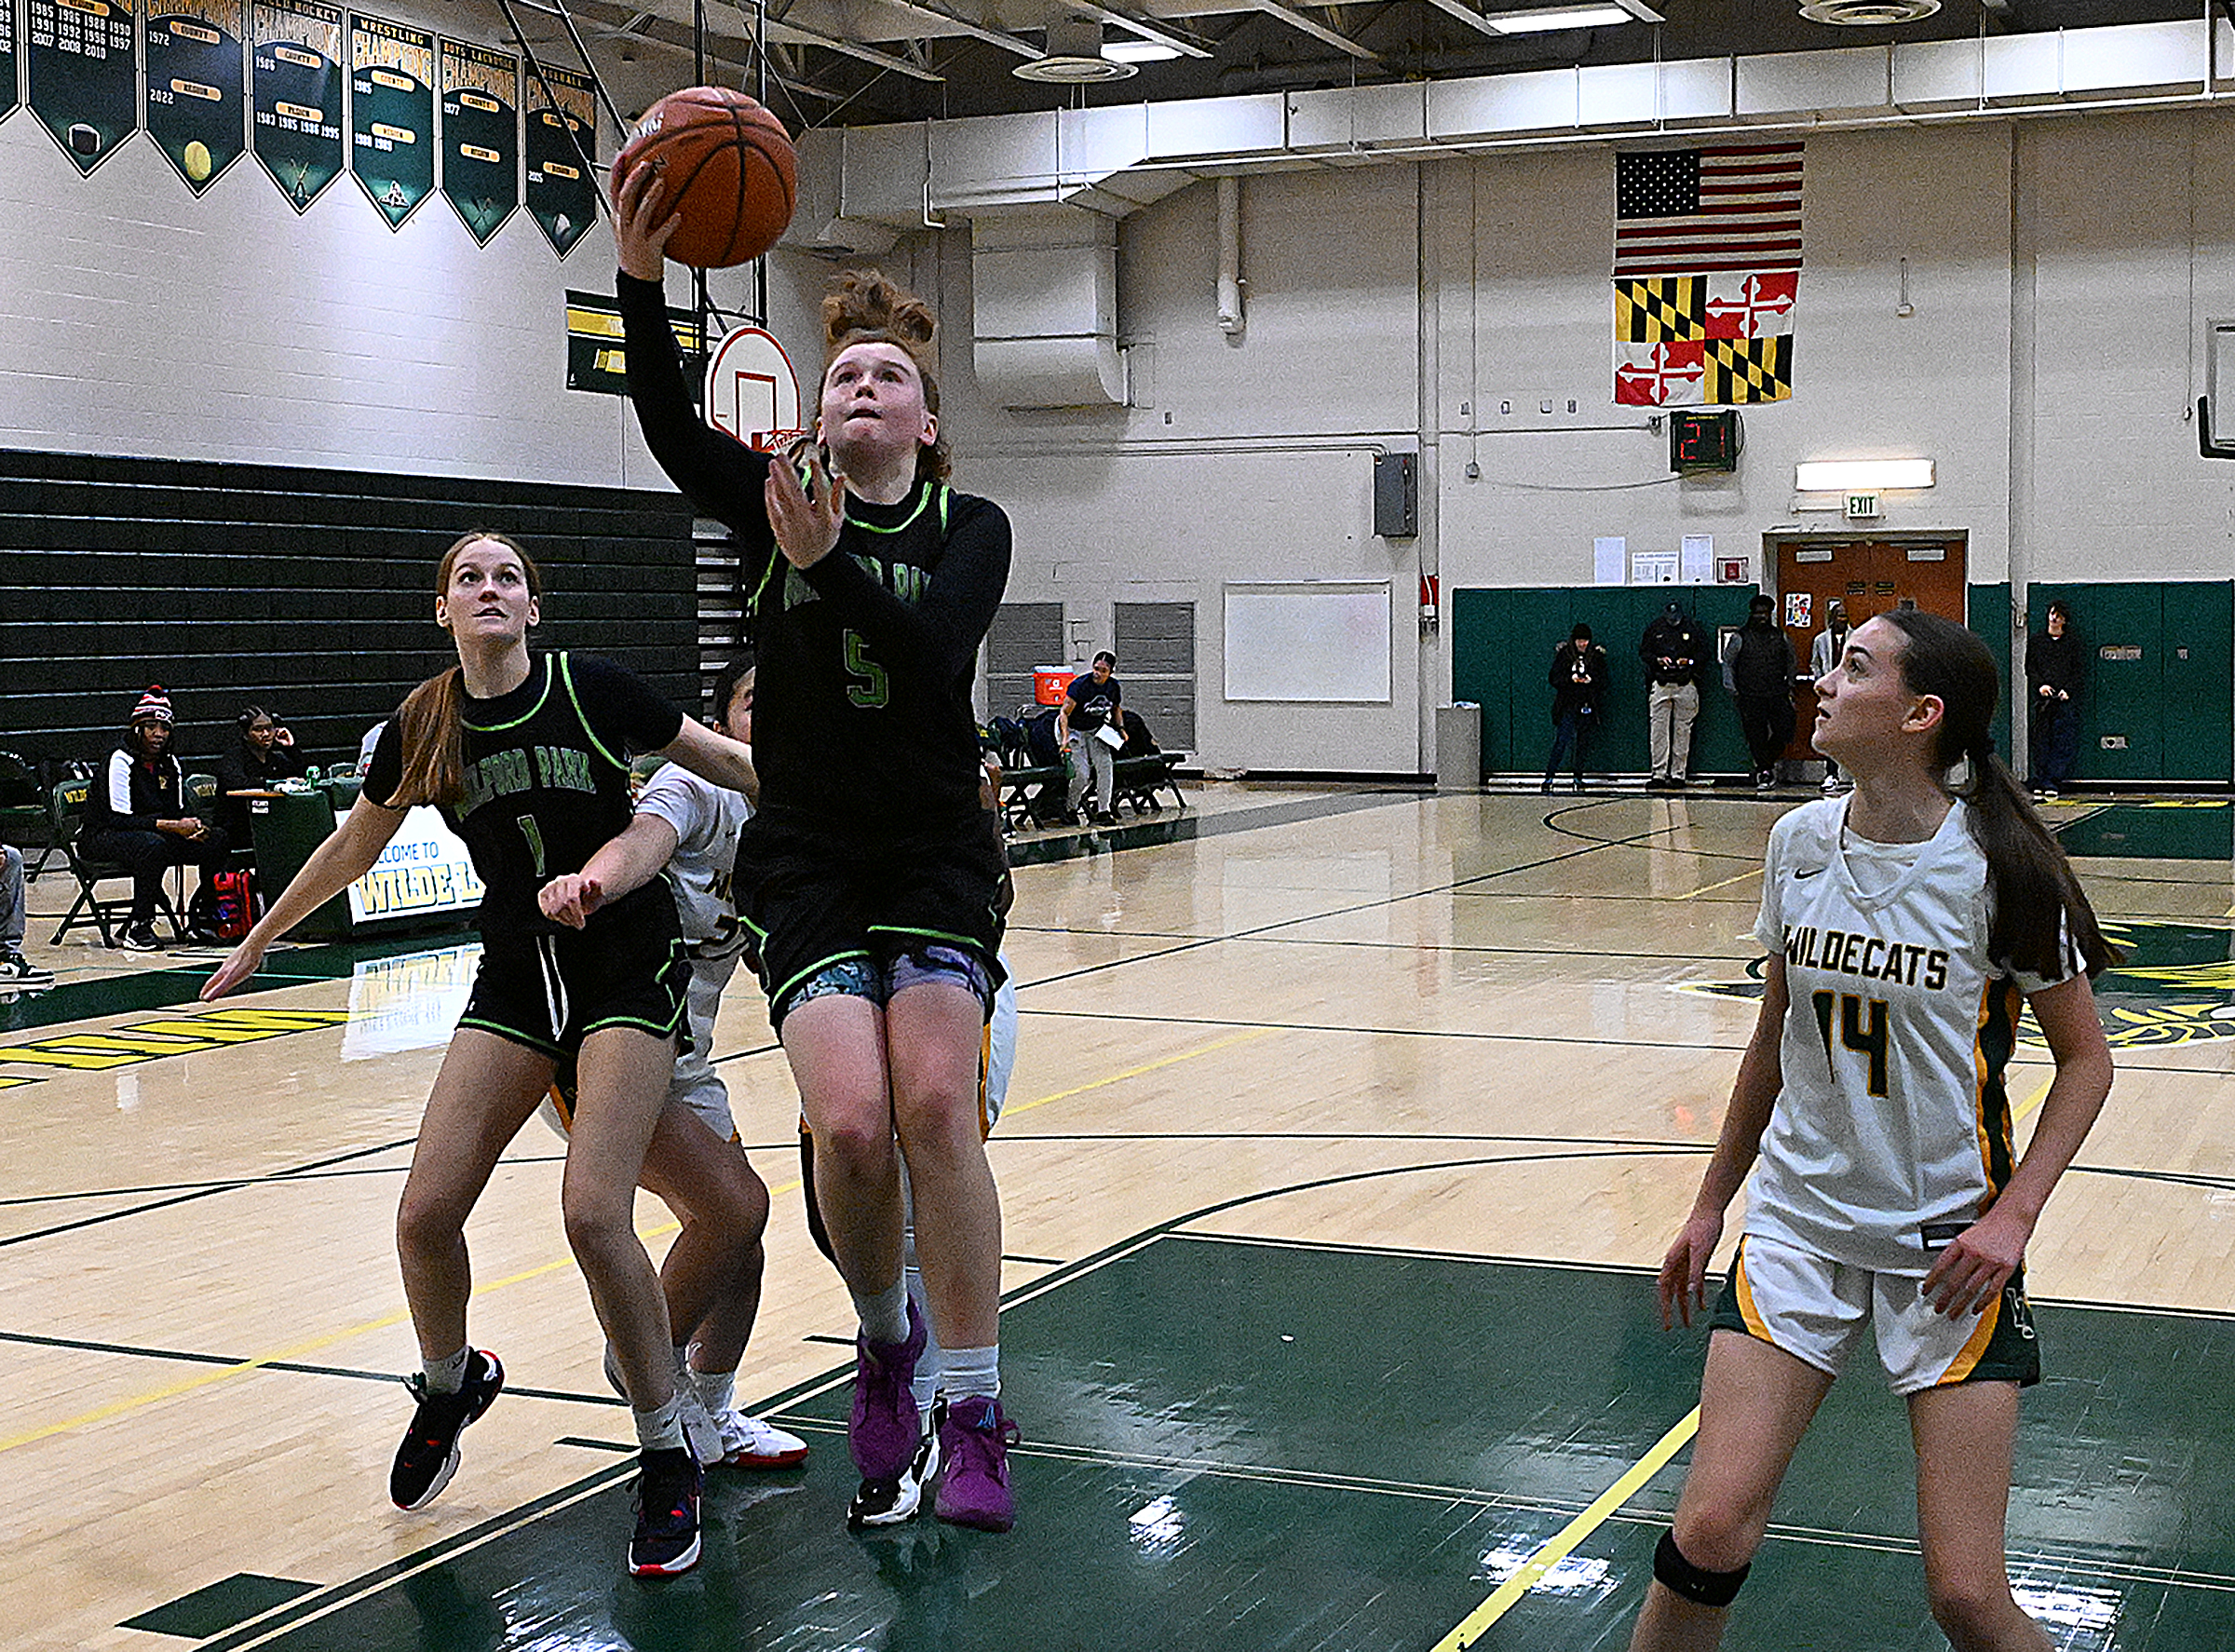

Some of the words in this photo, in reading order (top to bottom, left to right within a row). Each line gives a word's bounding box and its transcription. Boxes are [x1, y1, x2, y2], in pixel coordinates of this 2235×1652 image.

[294, 2, 337, 21] HOCKEY
[32, 16, 54, 34] 1991
[58, 22, 81, 39] 1992
[110, 34, 131, 50] 1997
[110, 20, 131, 36] 1990
[149, 31, 169, 46] 1972
[360, 19, 424, 45] WRESTLING
[33, 31, 55, 47] 2007
[59, 37, 81, 54] 2008
[85, 44, 106, 60] 2010
[543, 69, 583, 88] ASEBALL
[150, 88, 173, 104] 2022
[1849, 496, 1875, 514] EXIT
[843, 629, 889, 709] 5
[535, 746, 597, 794] PARK
[422, 842, 439, 859] TO
[517, 814, 546, 877] 1
[355, 863, 455, 915] WILDE
[1782, 924, 1950, 991] WILDECATS
[1812, 989, 1889, 1100] 14
